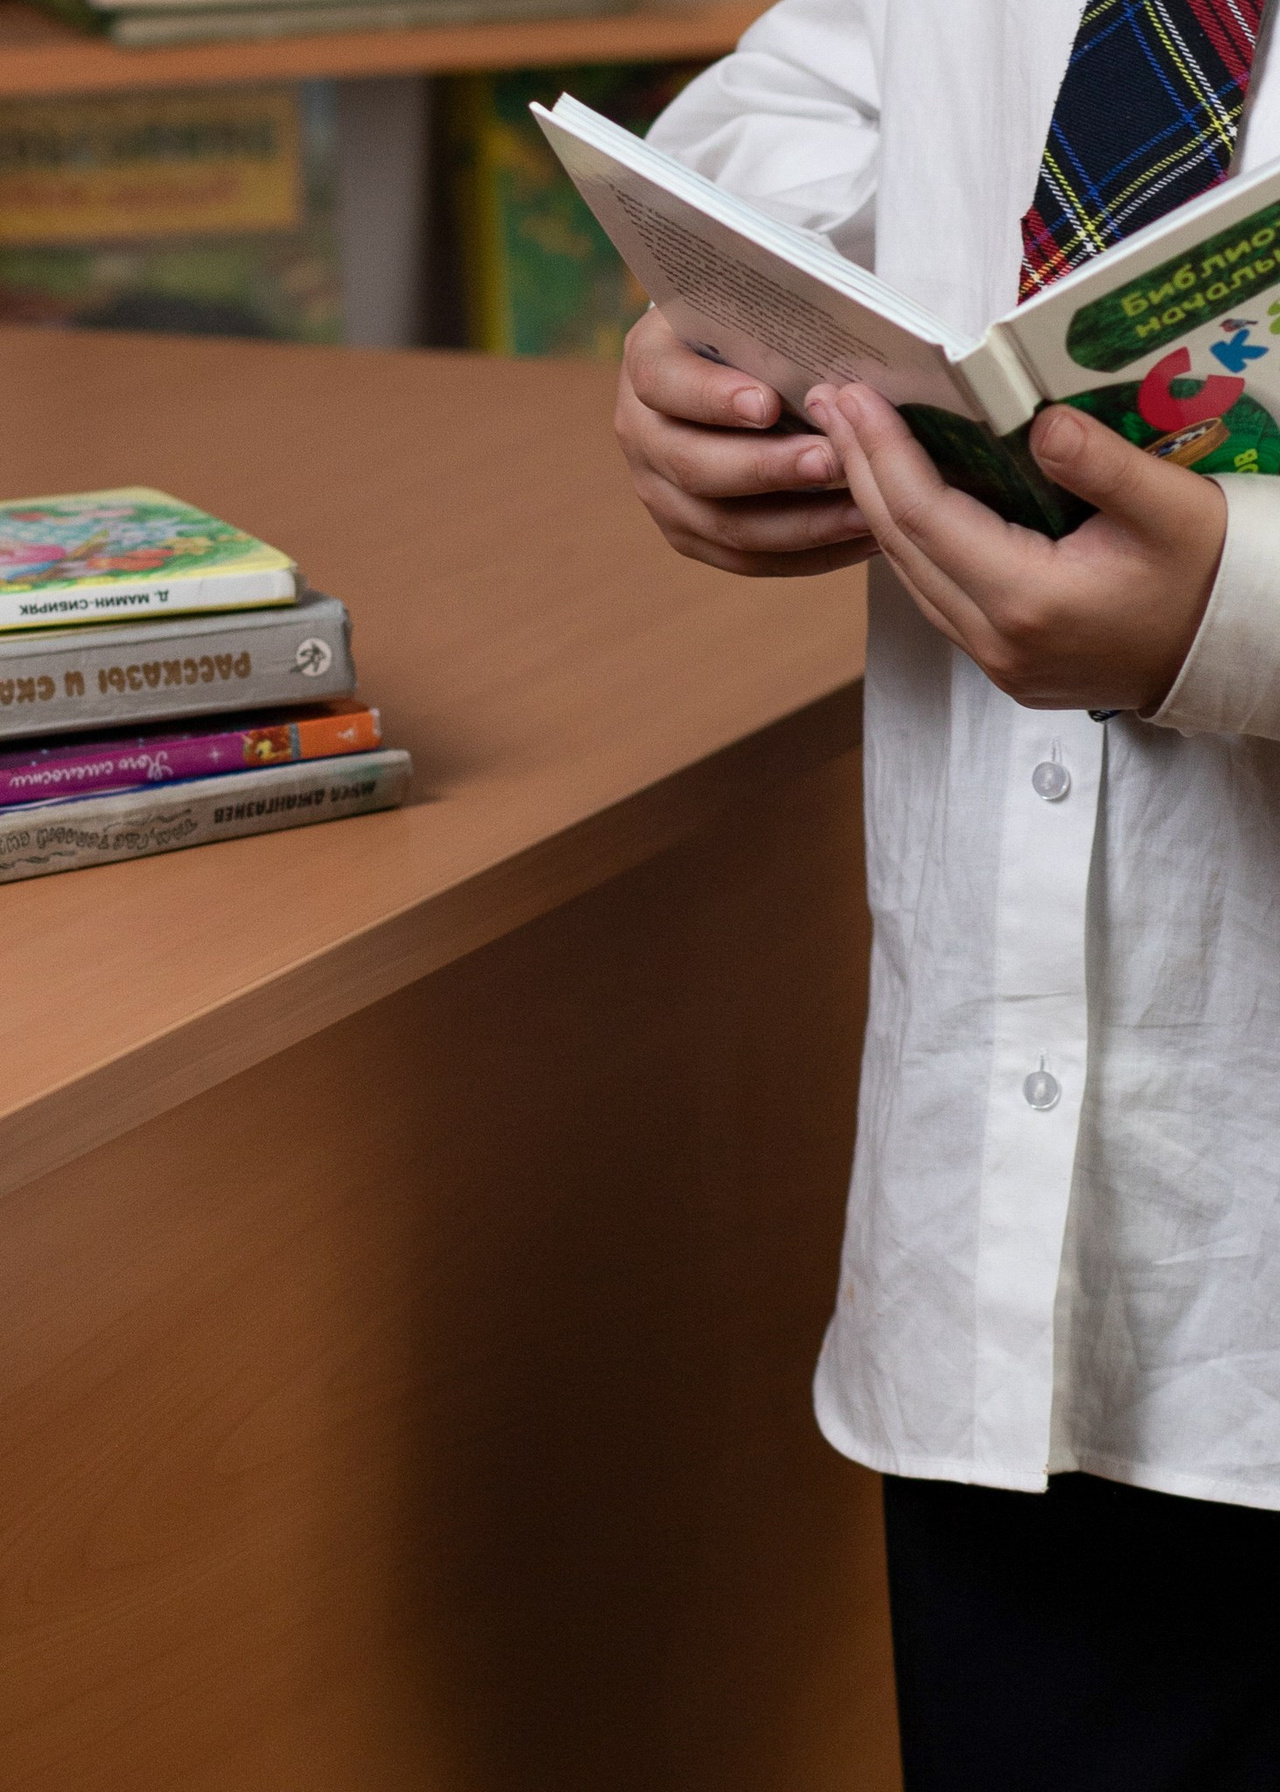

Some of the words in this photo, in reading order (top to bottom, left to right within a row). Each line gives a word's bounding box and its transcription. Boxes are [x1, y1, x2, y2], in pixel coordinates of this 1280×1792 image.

[20, 593, 150, 615] МАМИН-СИБИРЯК
[65, 671, 85, 697] И
[100, 652, 251, 693] РАССКАЗЫ
[9, 761, 114, 788] смелости
